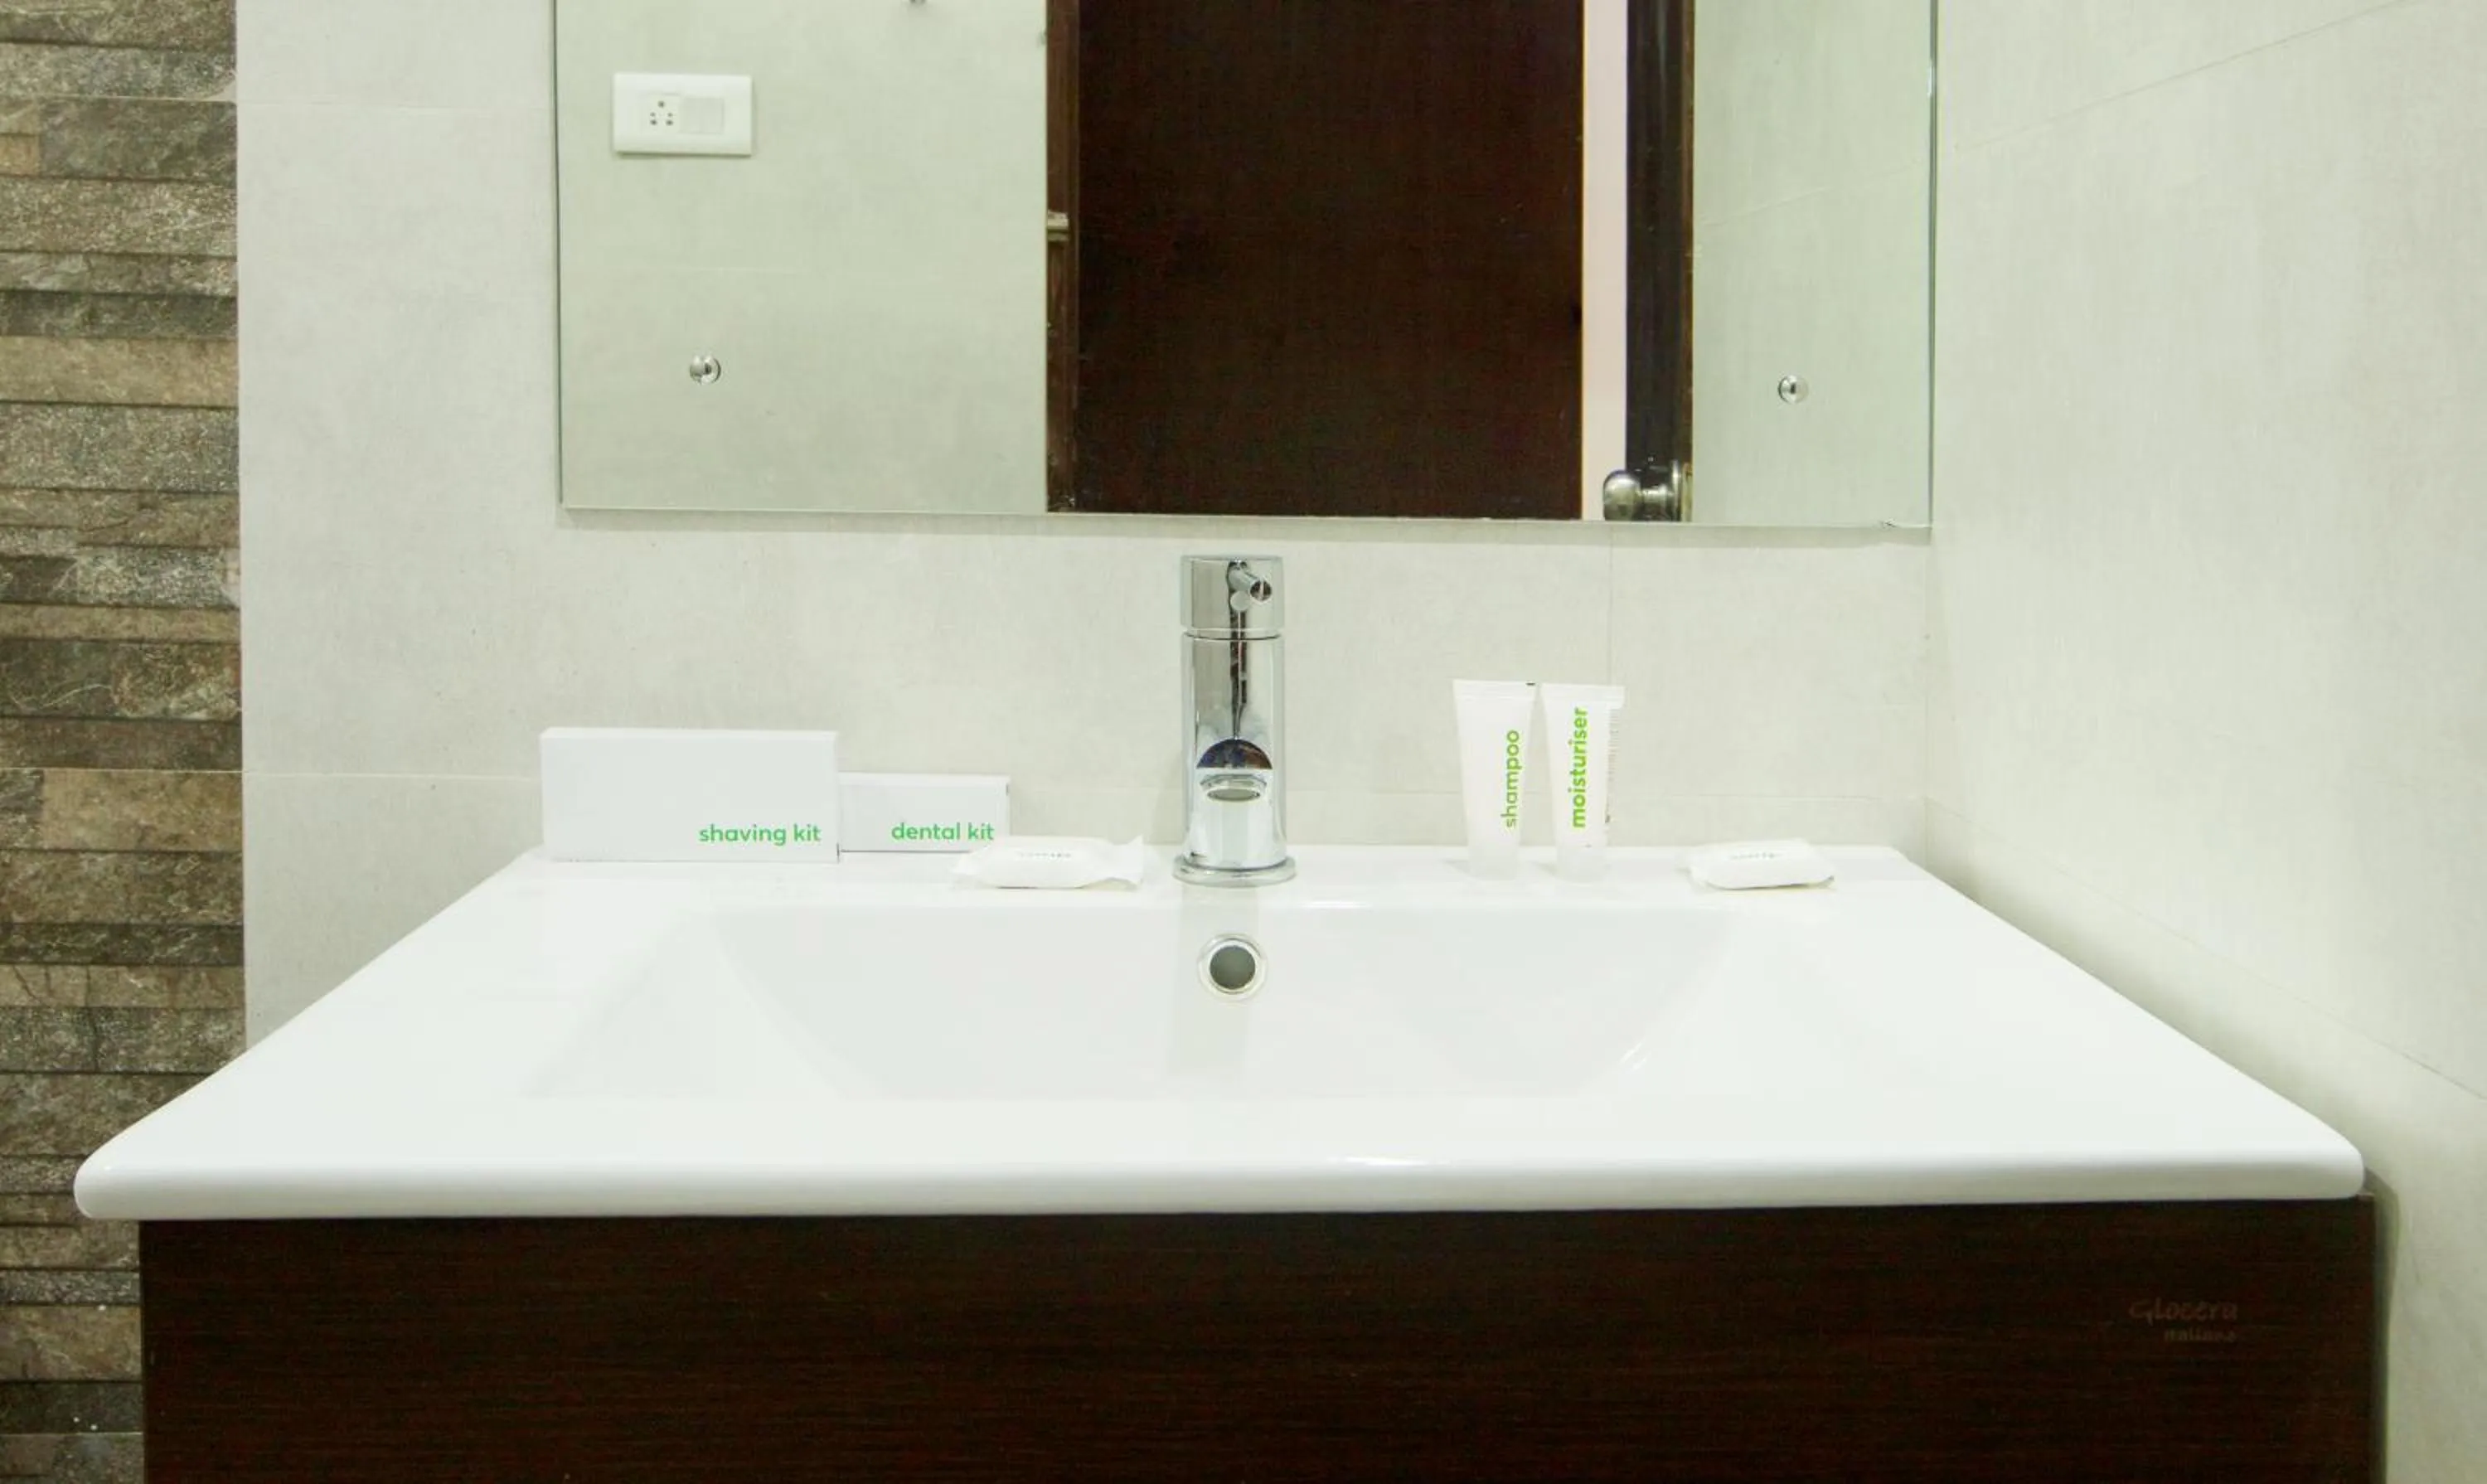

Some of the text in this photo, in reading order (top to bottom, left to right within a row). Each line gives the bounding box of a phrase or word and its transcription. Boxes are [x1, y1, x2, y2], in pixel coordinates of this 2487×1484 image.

[1501, 730, 1523, 827] shampoo
[1568, 707, 1589, 828] moisturiser
[699, 823, 822, 846] shaving kit
[891, 822, 995, 841] dental kit
